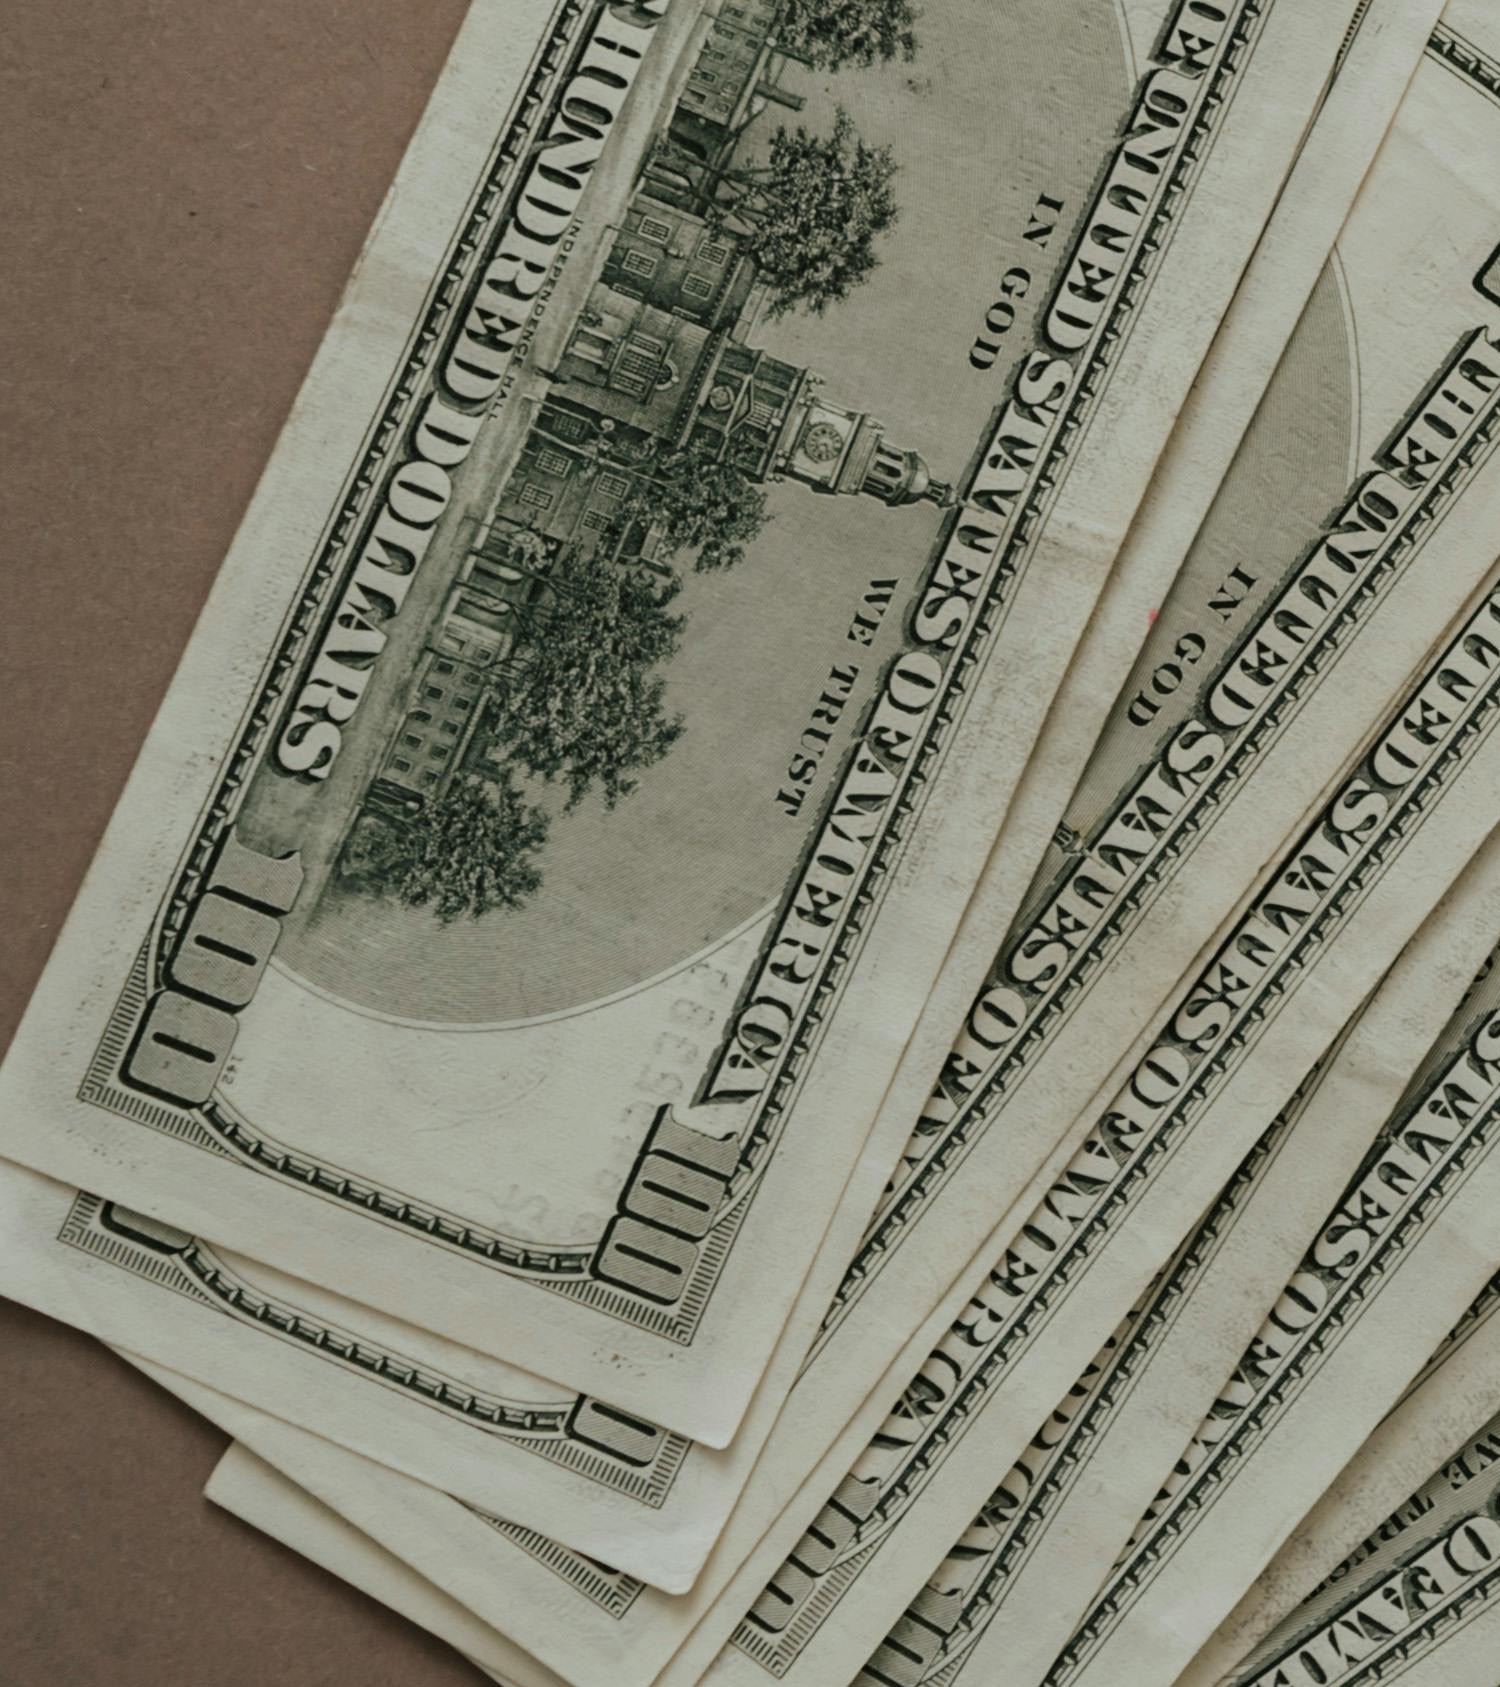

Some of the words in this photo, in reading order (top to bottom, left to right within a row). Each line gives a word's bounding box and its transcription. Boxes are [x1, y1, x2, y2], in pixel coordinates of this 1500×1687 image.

[426, 0, 658, 413] HUNDRED
[509, 216, 584, 368] INDEPENDENCE
[1017, 189, 1065, 251] IN
[1027, 45, 1209, 368] UNITED
[486, 374, 515, 425] HALL
[962, 260, 1035, 376] GOD
[260, 379, 490, 792] DOLLARS
[900, 335, 1081, 658] STATES
[842, 568, 900, 653] WE
[1116, 625, 1210, 734] GOD
[1192, 460, 1422, 734] UNITED
[1199, 561, 1259, 627] IN
[769, 658, 861, 819] TRUST
[850, 643, 947, 772] OF
[694, 737, 906, 1126] AMERICA
[989, 704, 1236, 1002] STATES
[1150, 765, 1400, 1066] STATES
[125, 842, 305, 1107] 100
[1083, 1035, 1198, 1161] OF
[591, 1098, 741, 1308] 100
